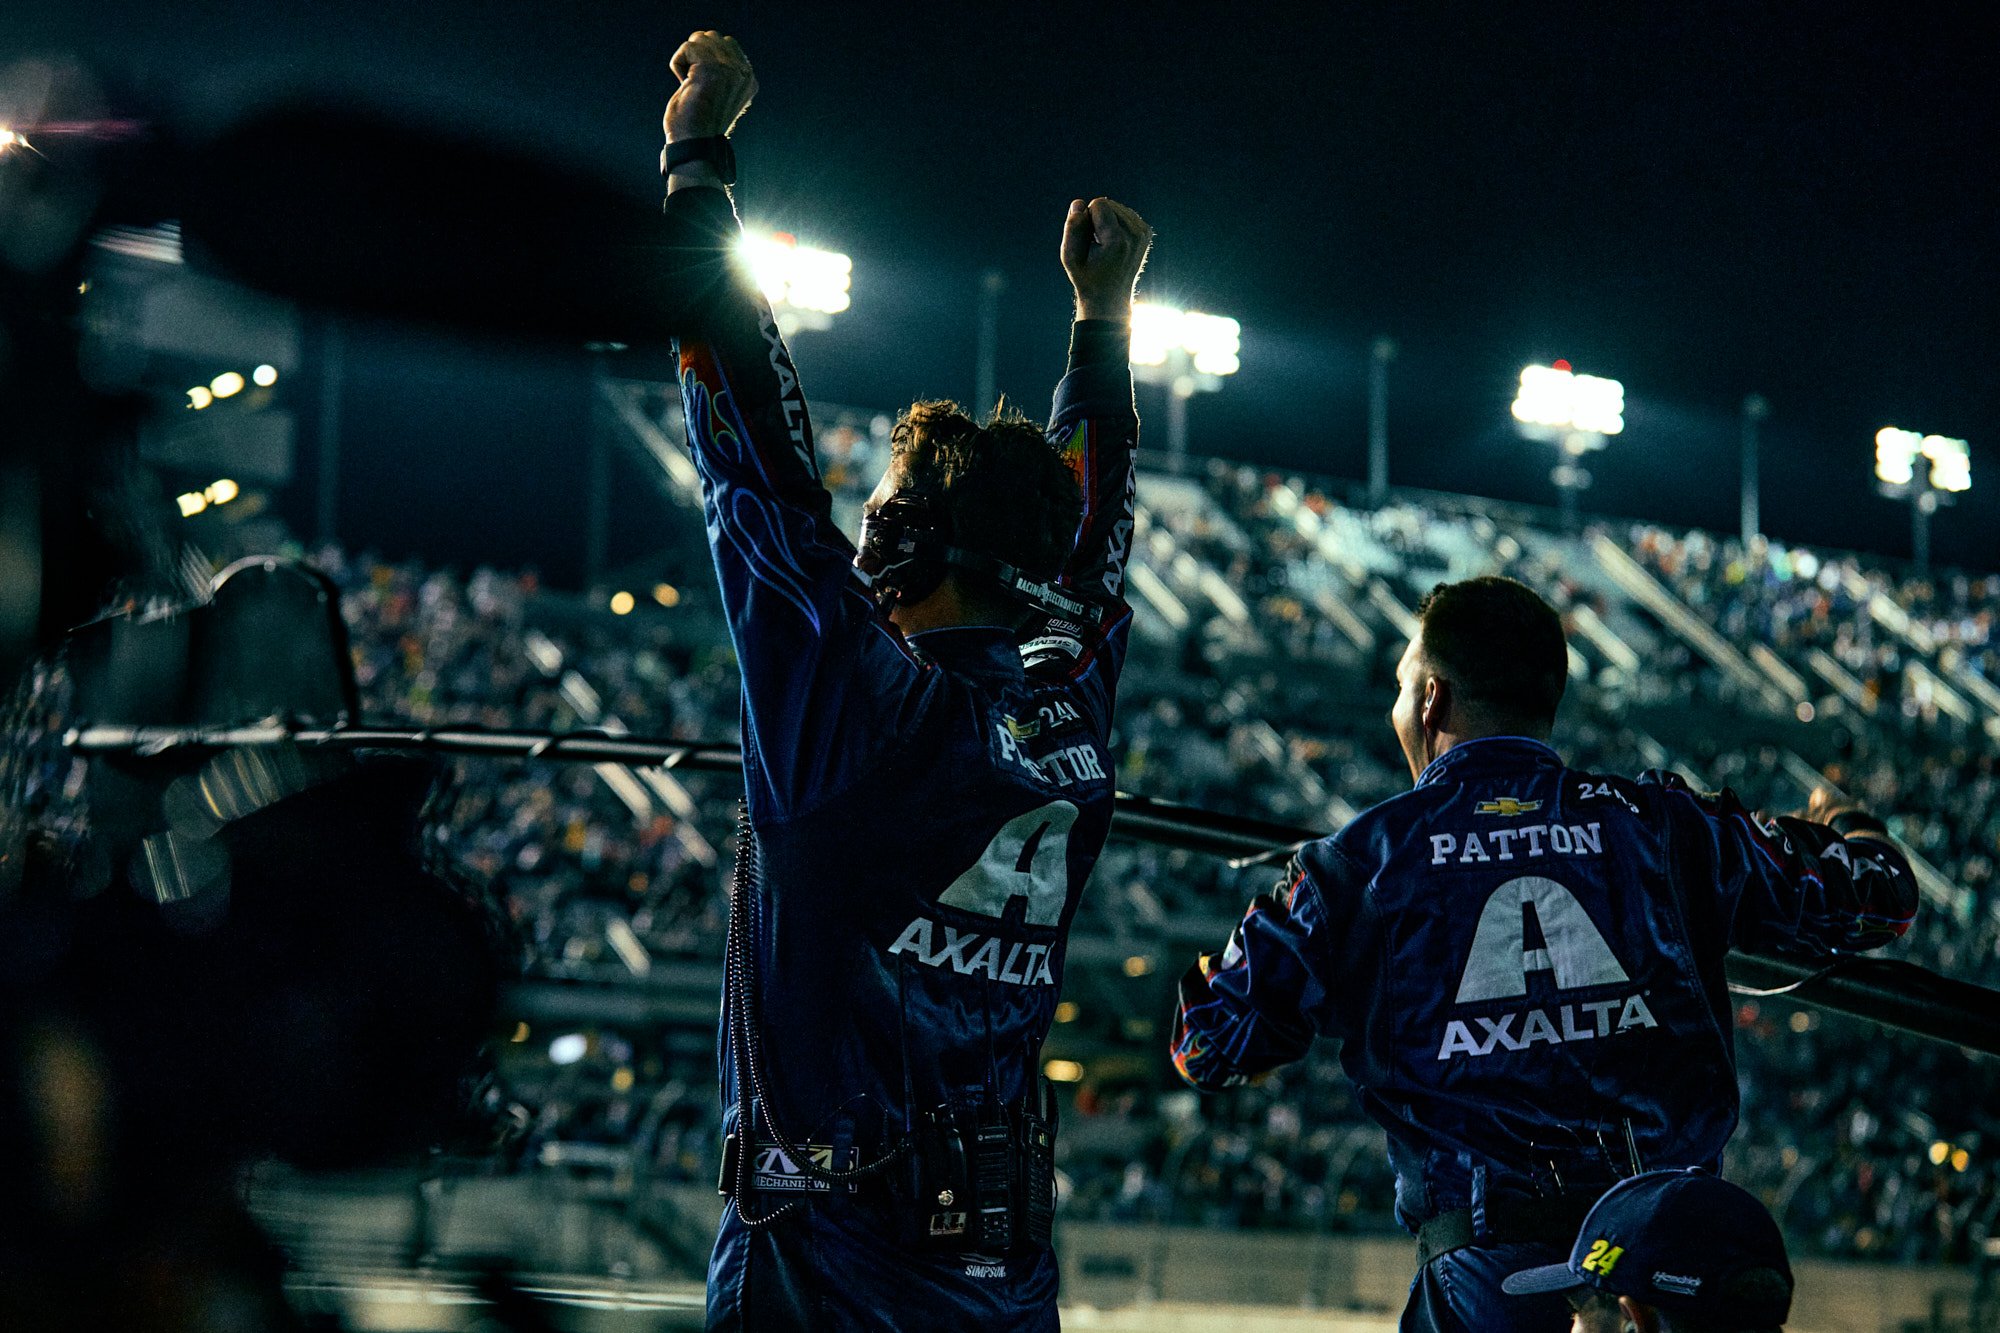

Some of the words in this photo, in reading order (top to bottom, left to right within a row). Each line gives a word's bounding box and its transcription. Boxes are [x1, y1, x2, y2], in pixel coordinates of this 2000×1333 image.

[1429, 822, 1603, 865] PATTON
[888, 916, 1054, 986] AXALTA
[1437, 993, 1659, 1061] AXALTA
[965, 1264, 1006, 1279] SIMPSON
[1581, 1238, 1625, 1277] 24
